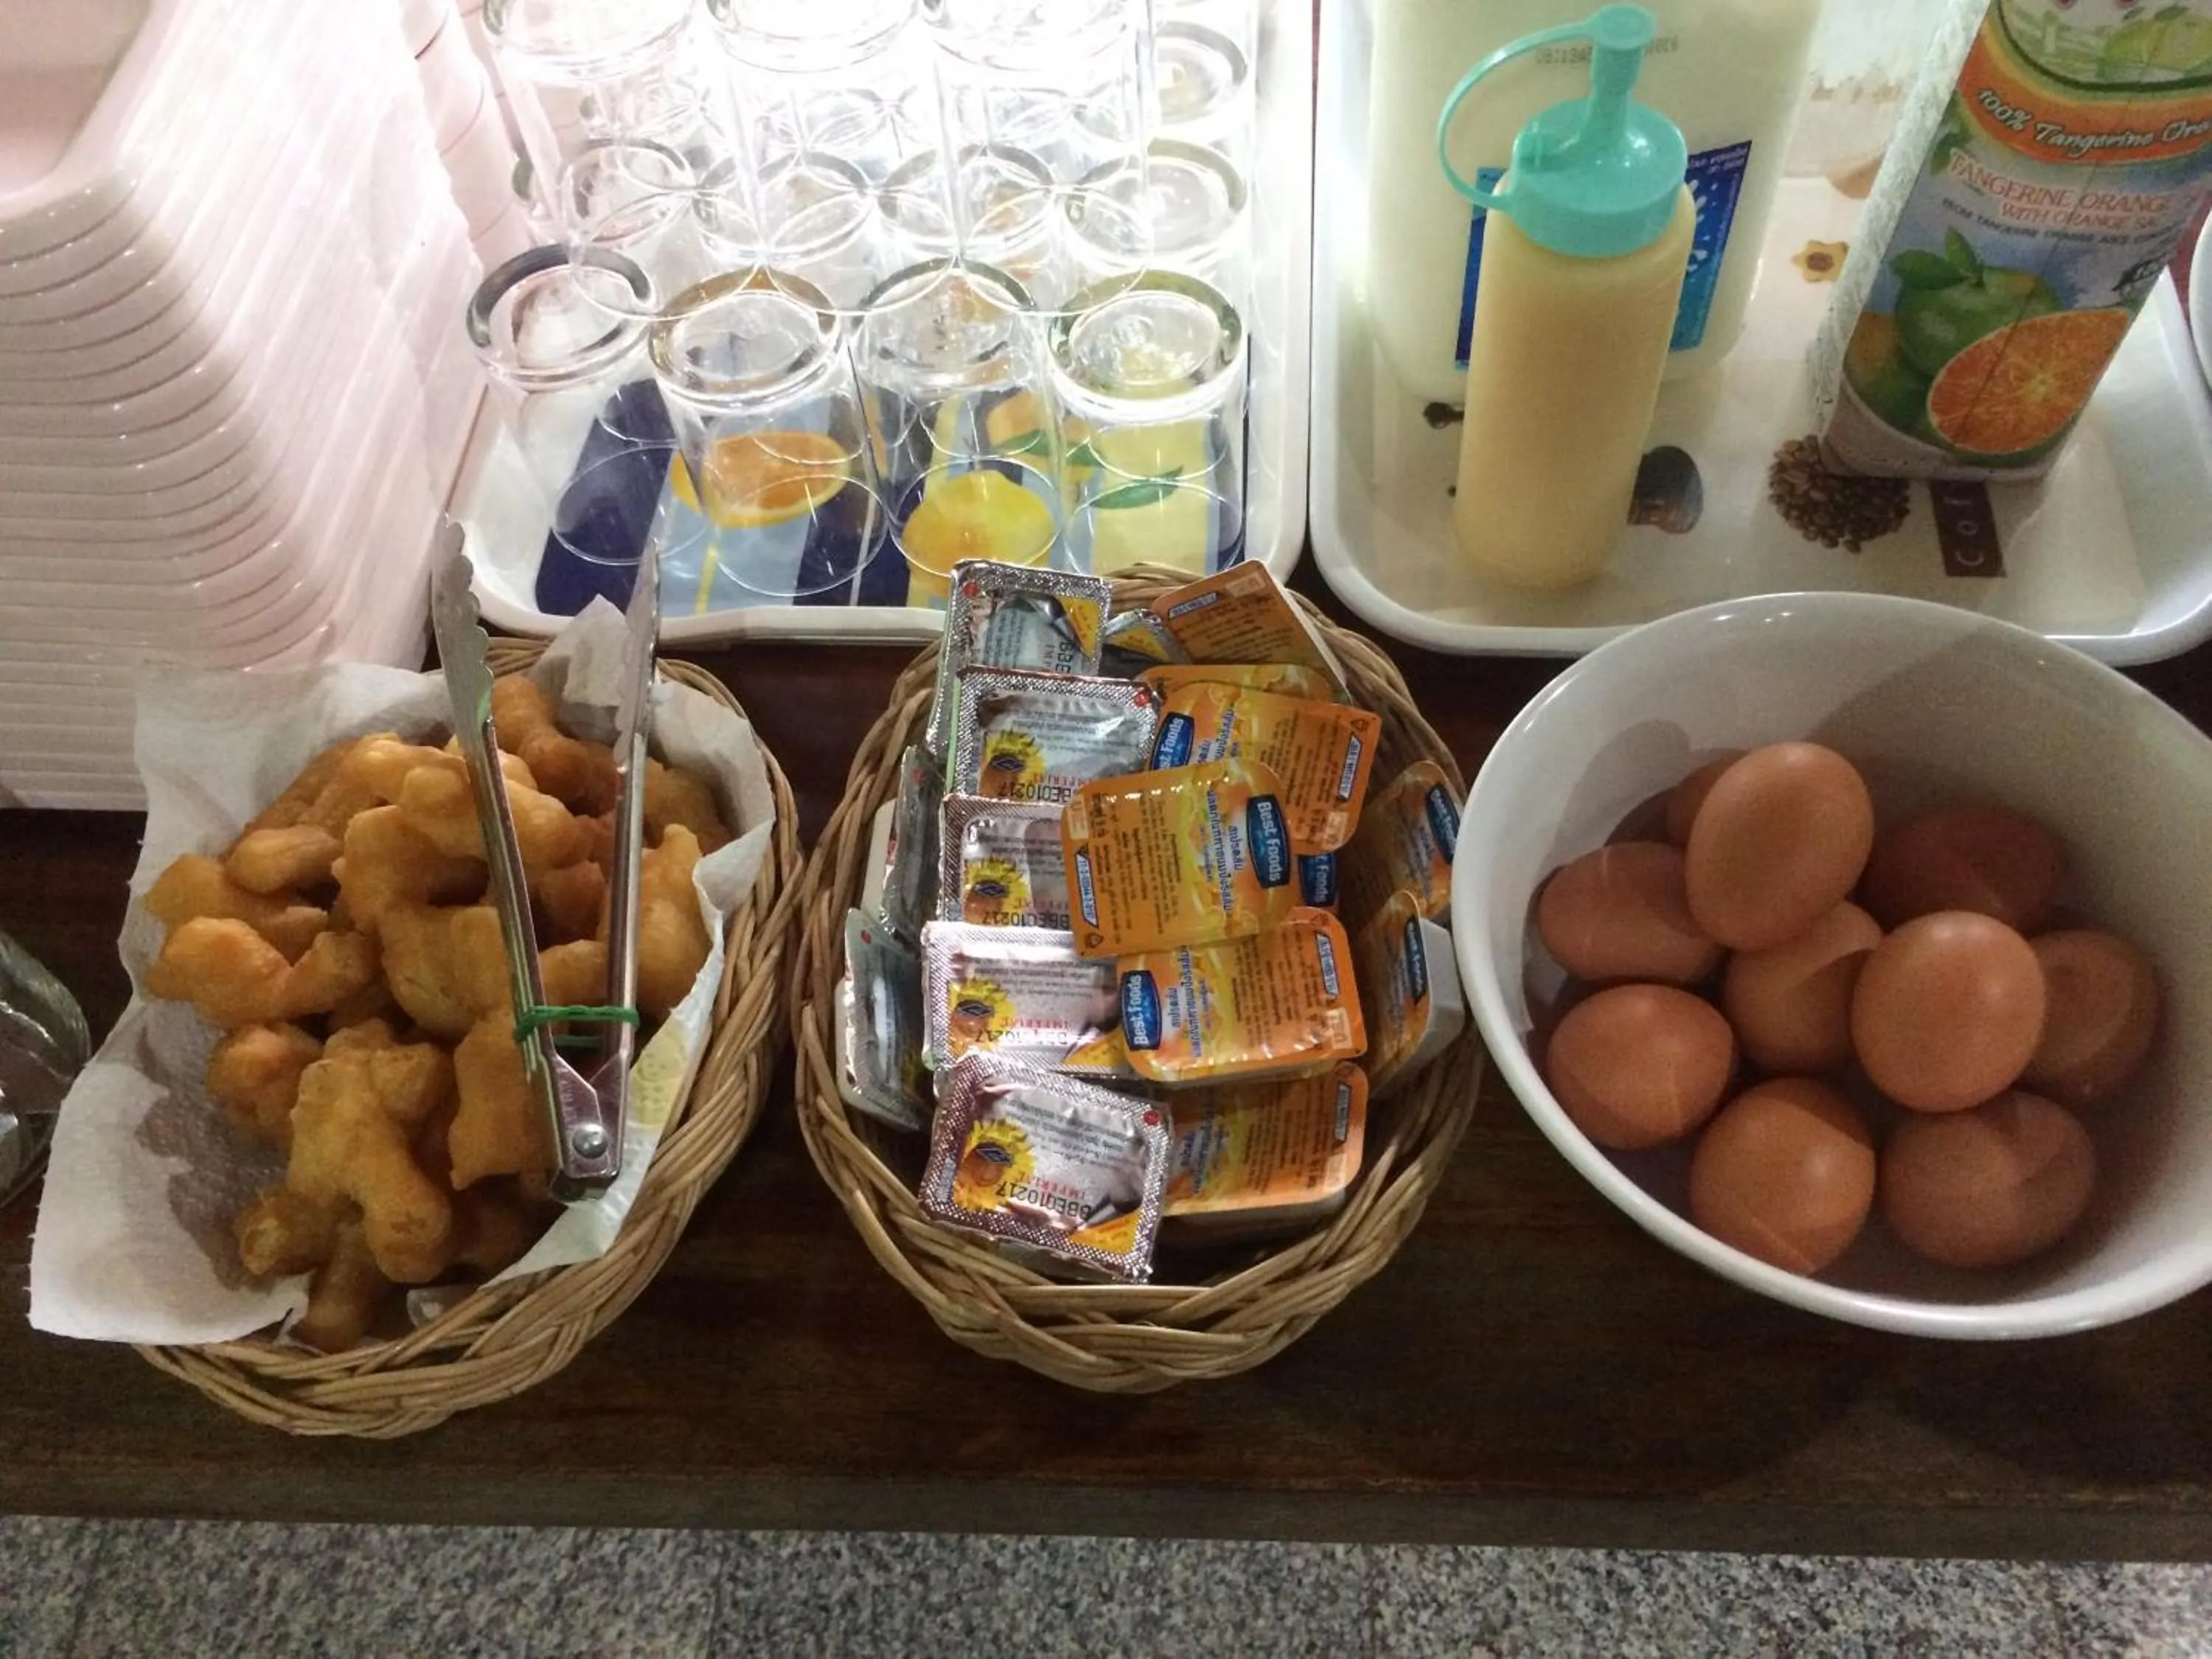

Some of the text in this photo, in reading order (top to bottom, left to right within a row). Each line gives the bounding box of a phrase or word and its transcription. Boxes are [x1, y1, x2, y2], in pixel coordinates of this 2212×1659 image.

[1978, 88, 2034, 133] 100%
[2034, 122, 2154, 160] Tangerine
[1950, 153, 2076, 209] TANGERINE
[2001, 201, 2050, 223] WITH
[2053, 210, 2127, 229] ORANGE
[1158, 717, 1184, 754] Foods
[998, 781, 1075, 804] BE010217
[1256, 801, 1283, 882] Best Foods
[1125, 974, 1150, 1046] Best Foods
[995, 1180, 1091, 1222] BBE010217
